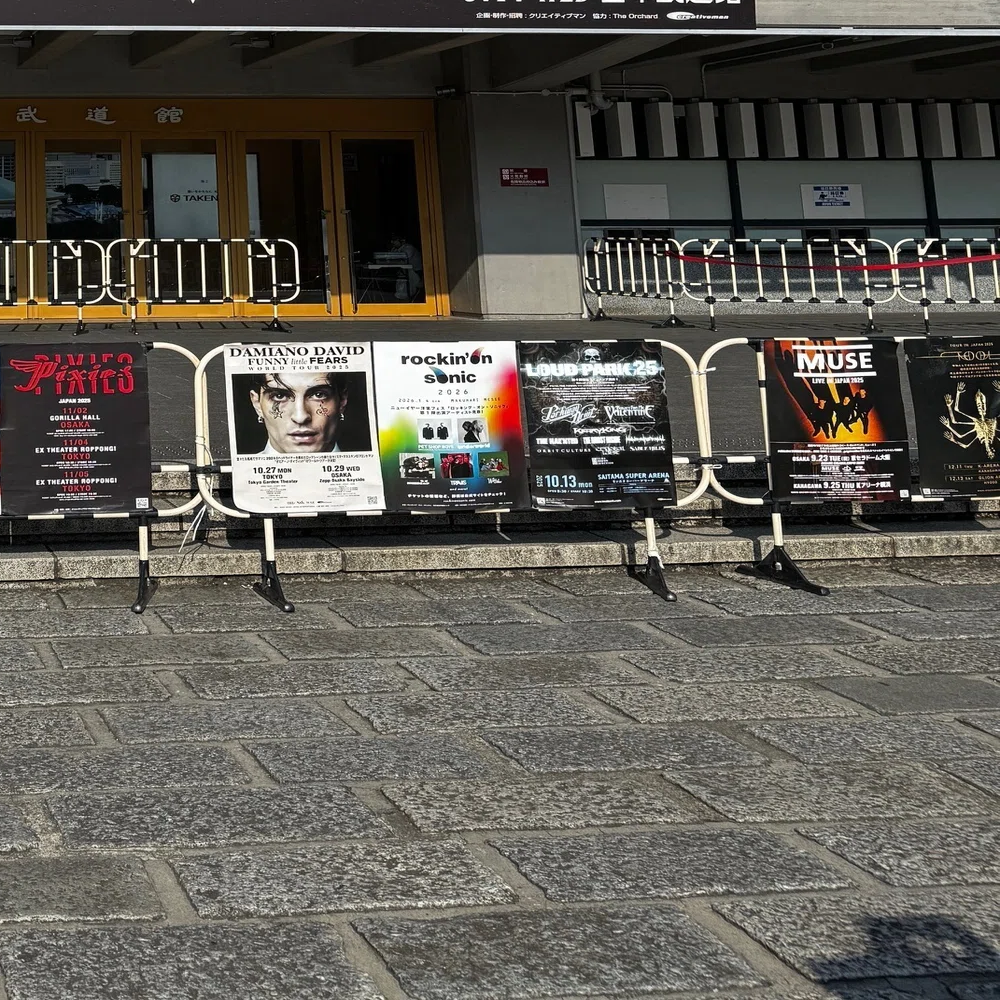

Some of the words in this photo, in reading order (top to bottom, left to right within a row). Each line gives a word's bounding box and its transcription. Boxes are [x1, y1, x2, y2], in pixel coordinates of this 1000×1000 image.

[628, 11, 659, 20] Orchard
[230, 346, 309, 357] DAMIANO
[314, 345, 365, 356] DAVID
[248, 357, 290, 366] FUNNY
[290, 357, 308, 365] little
[309, 356, 349, 364] FEARS
[797, 352, 873, 370] MUSE
[424, 366, 477, 384] sonic
[525, 363, 579, 377] LOUD
[581, 362, 631, 376] PARK
[322, 465, 345, 473] 10.29
[544, 474, 577, 488] 10.13
